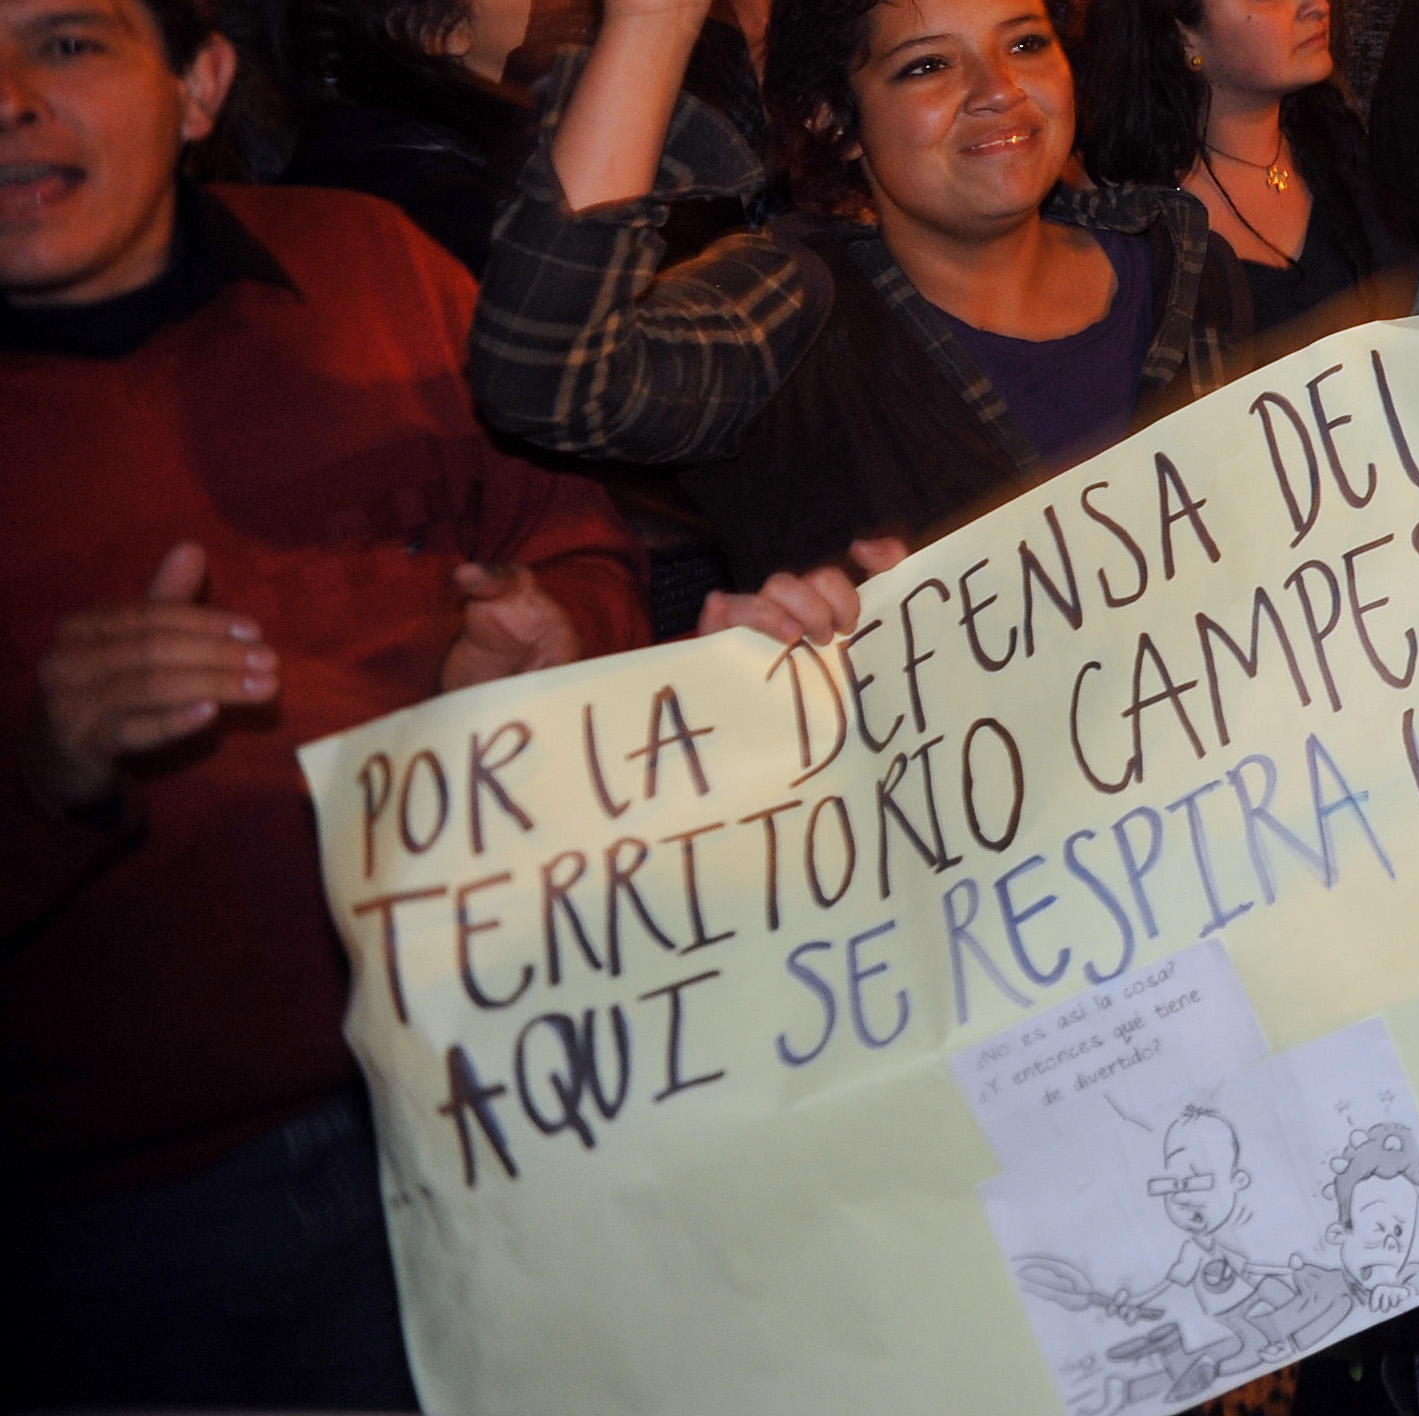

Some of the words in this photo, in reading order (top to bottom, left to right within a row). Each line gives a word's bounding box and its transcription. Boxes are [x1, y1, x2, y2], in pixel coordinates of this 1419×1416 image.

[357, 720, 535, 879] POR
[582, 684, 715, 819] LA
[766, 451, 1222, 789] DEFENSA
[353, 717, 1025, 1025] TERRITORIO
[438, 971, 727, 1187] AQUI
[775, 919, 912, 1066] SE
[940, 733, 1397, 1027] RESPIRA
[1012, 1035, 1104, 1086] entonces
[1153, 989, 1201, 1019] tiene
[1042, 1089, 1064, 1106] de
[1094, 994, 1113, 1011] la
